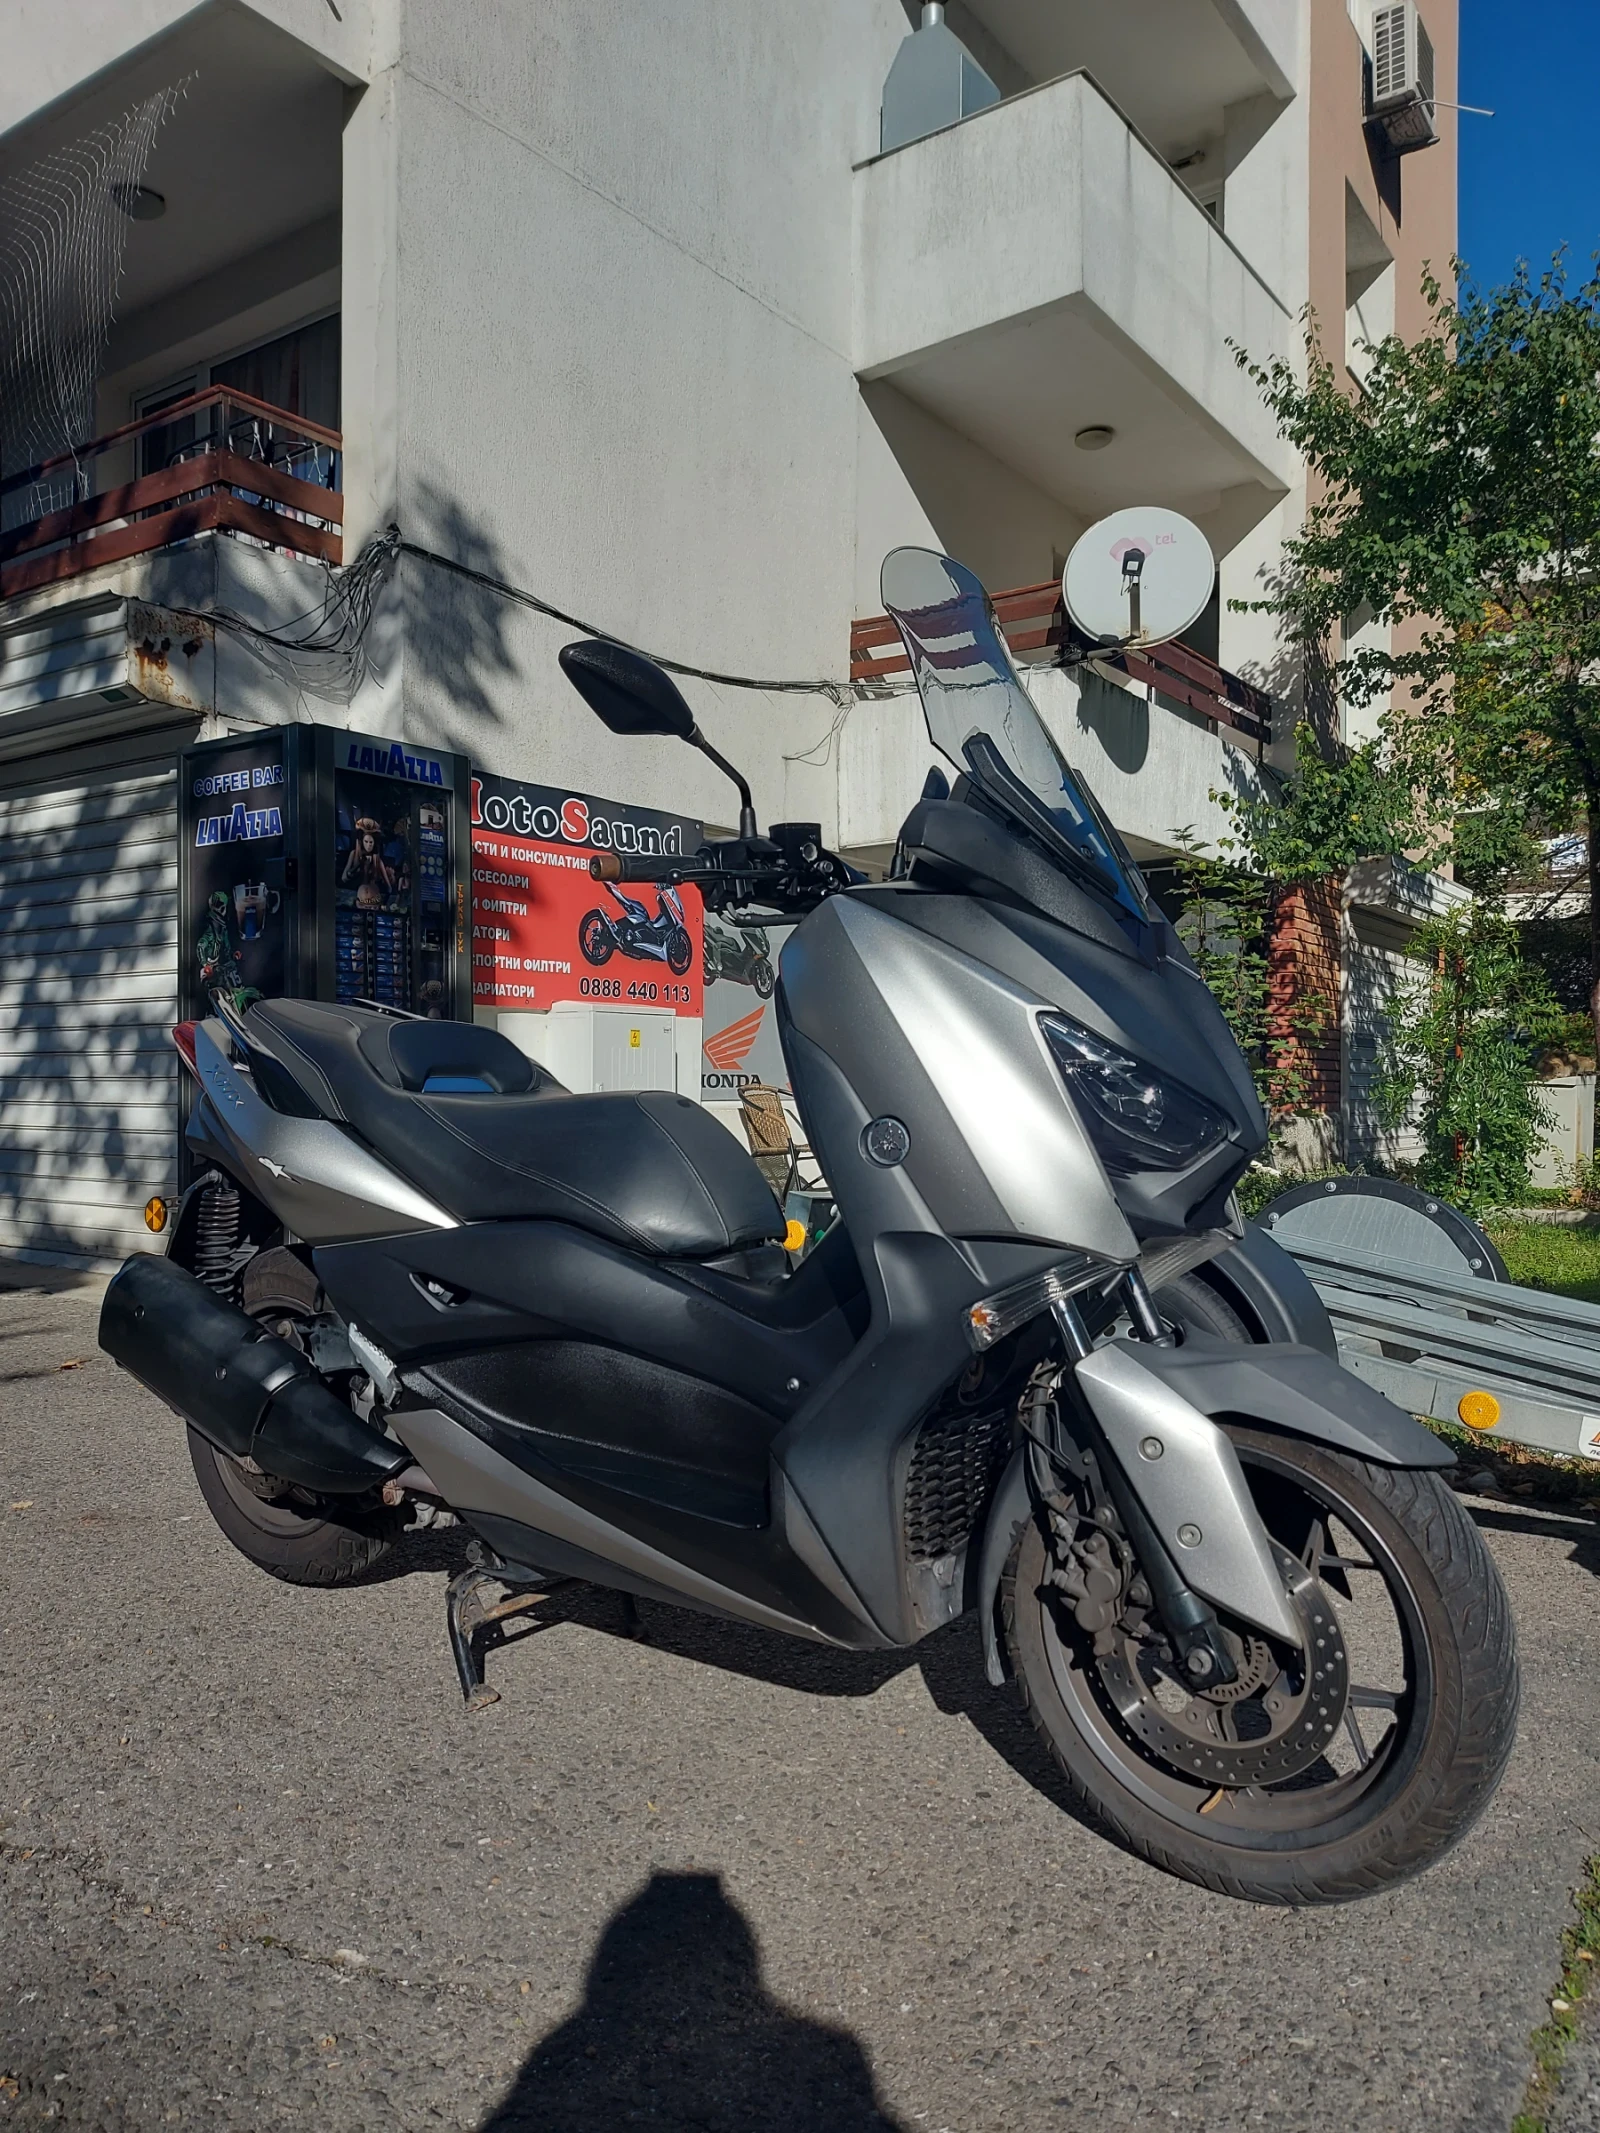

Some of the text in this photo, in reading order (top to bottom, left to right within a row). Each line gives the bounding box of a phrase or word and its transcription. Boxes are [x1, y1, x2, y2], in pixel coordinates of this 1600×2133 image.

[347, 743, 443, 786] LAVAZZA
[194, 765, 284, 797] COFFEE BAR
[195, 803, 283, 847] LAVAZZA
[472, 841, 498, 857] СТИ
[501, 845, 509, 858] И
[482, 898, 527, 916] ФИЛТРИ
[472, 953, 571, 974] ПОРТНИ ФИЛТРИ
[579, 976, 690, 1003] 0888 440 113
